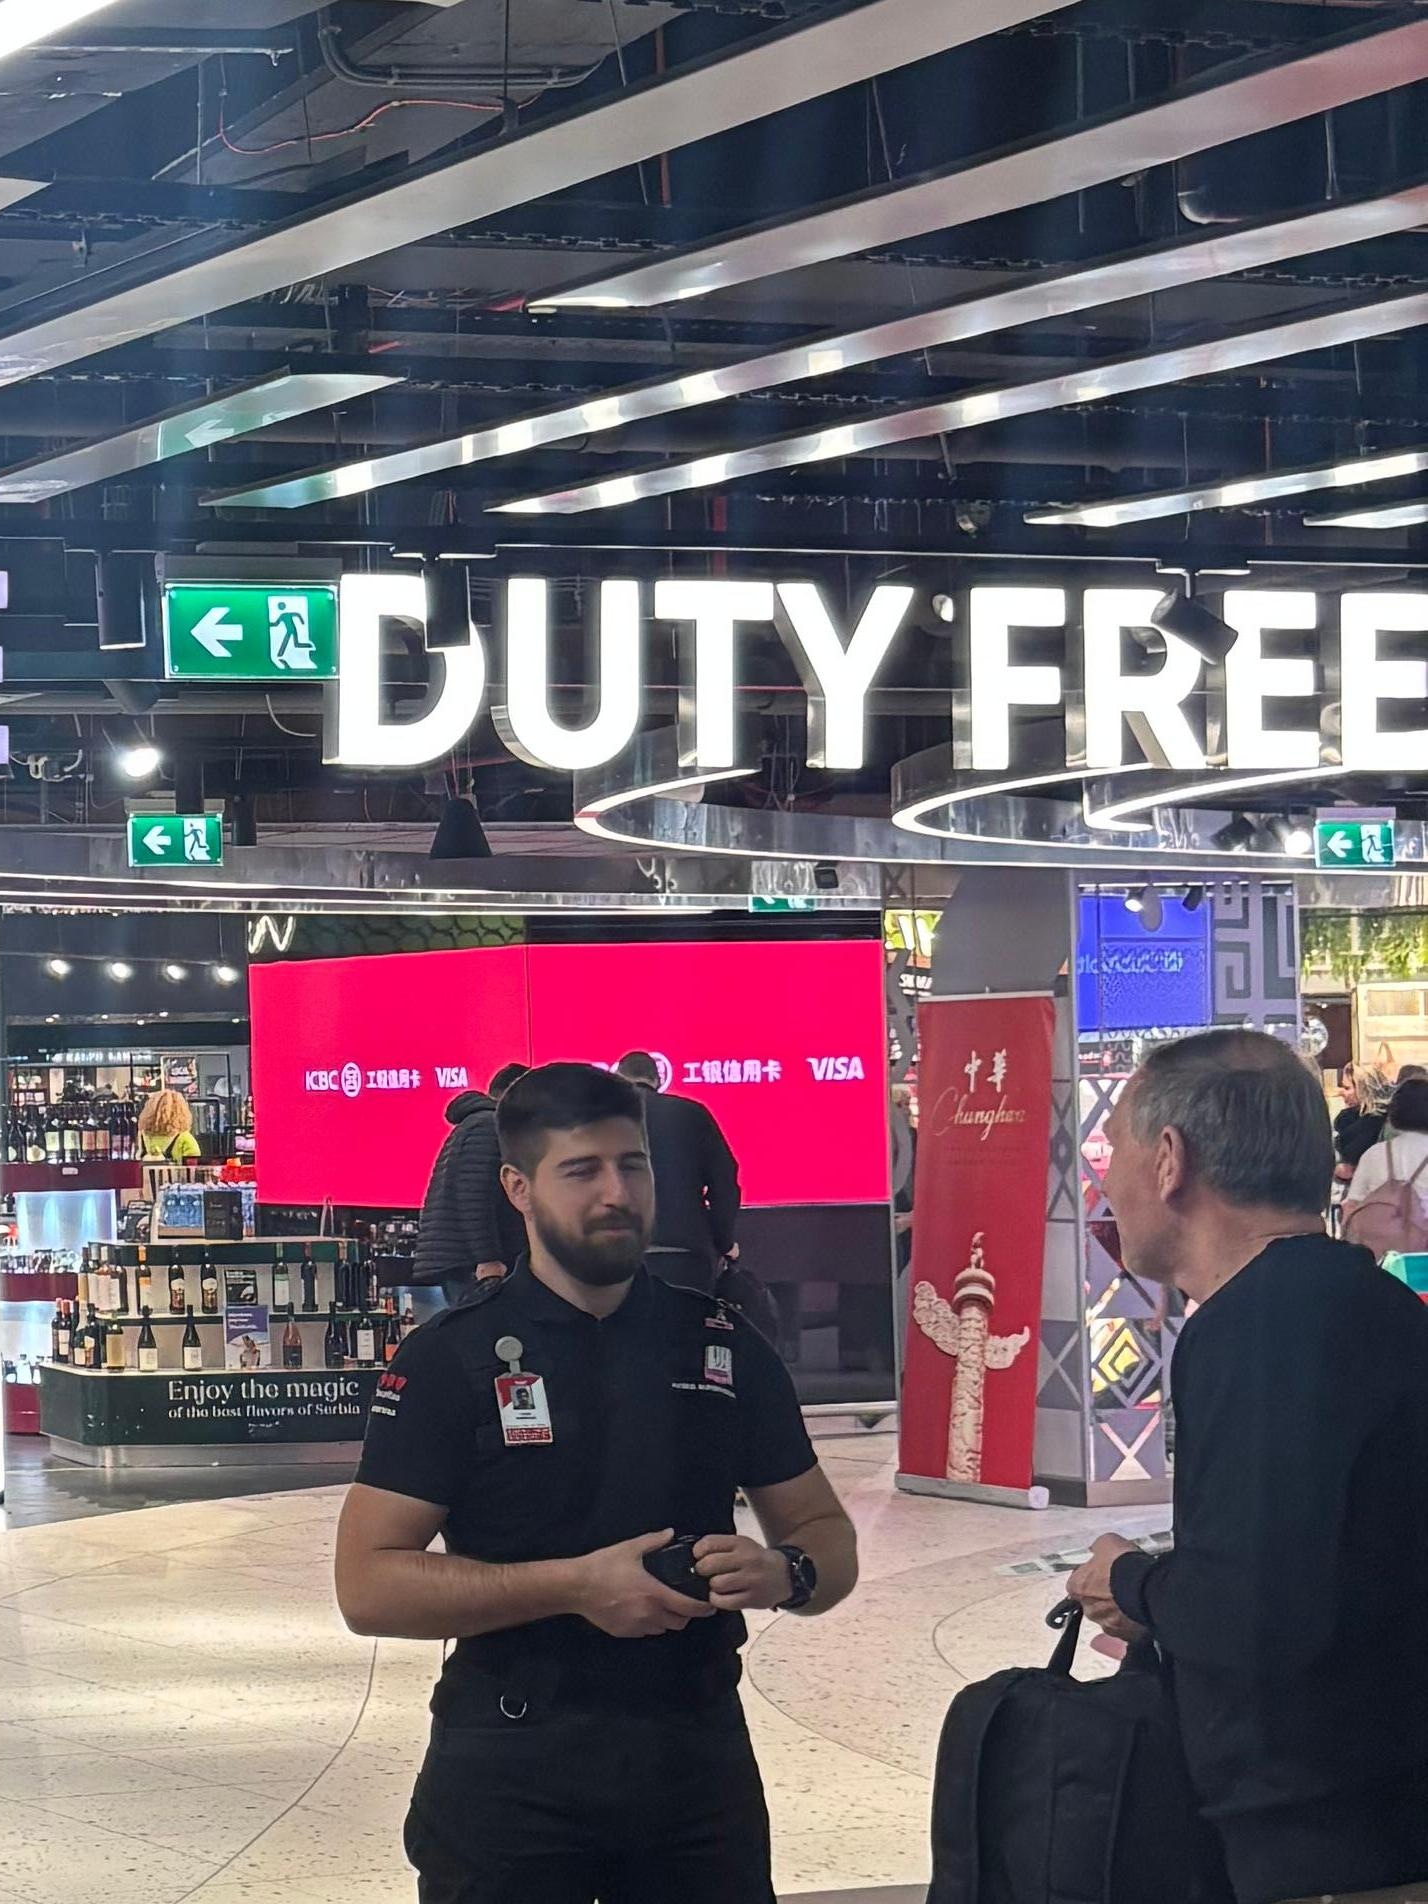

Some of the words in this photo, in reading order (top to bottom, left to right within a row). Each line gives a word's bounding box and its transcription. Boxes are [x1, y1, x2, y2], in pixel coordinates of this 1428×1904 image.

[326, 573, 916, 772] DUTY
[958, 585, 1428, 771] FREE
[435, 1067, 468, 1088] VISA
[806, 1056, 864, 1080] VISA
[168, 1379, 234, 1405] Enjoy
[241, 1378, 279, 1399] the
[287, 1376, 360, 1402] magic
[168, 1406, 184, 1419] of
[186, 1405, 209, 1419] the
[212, 1404, 242, 1419] best
[247, 1404, 295, 1418] flavors
[298, 1402, 312, 1417] of
[315, 1402, 361, 1416] Serbia
